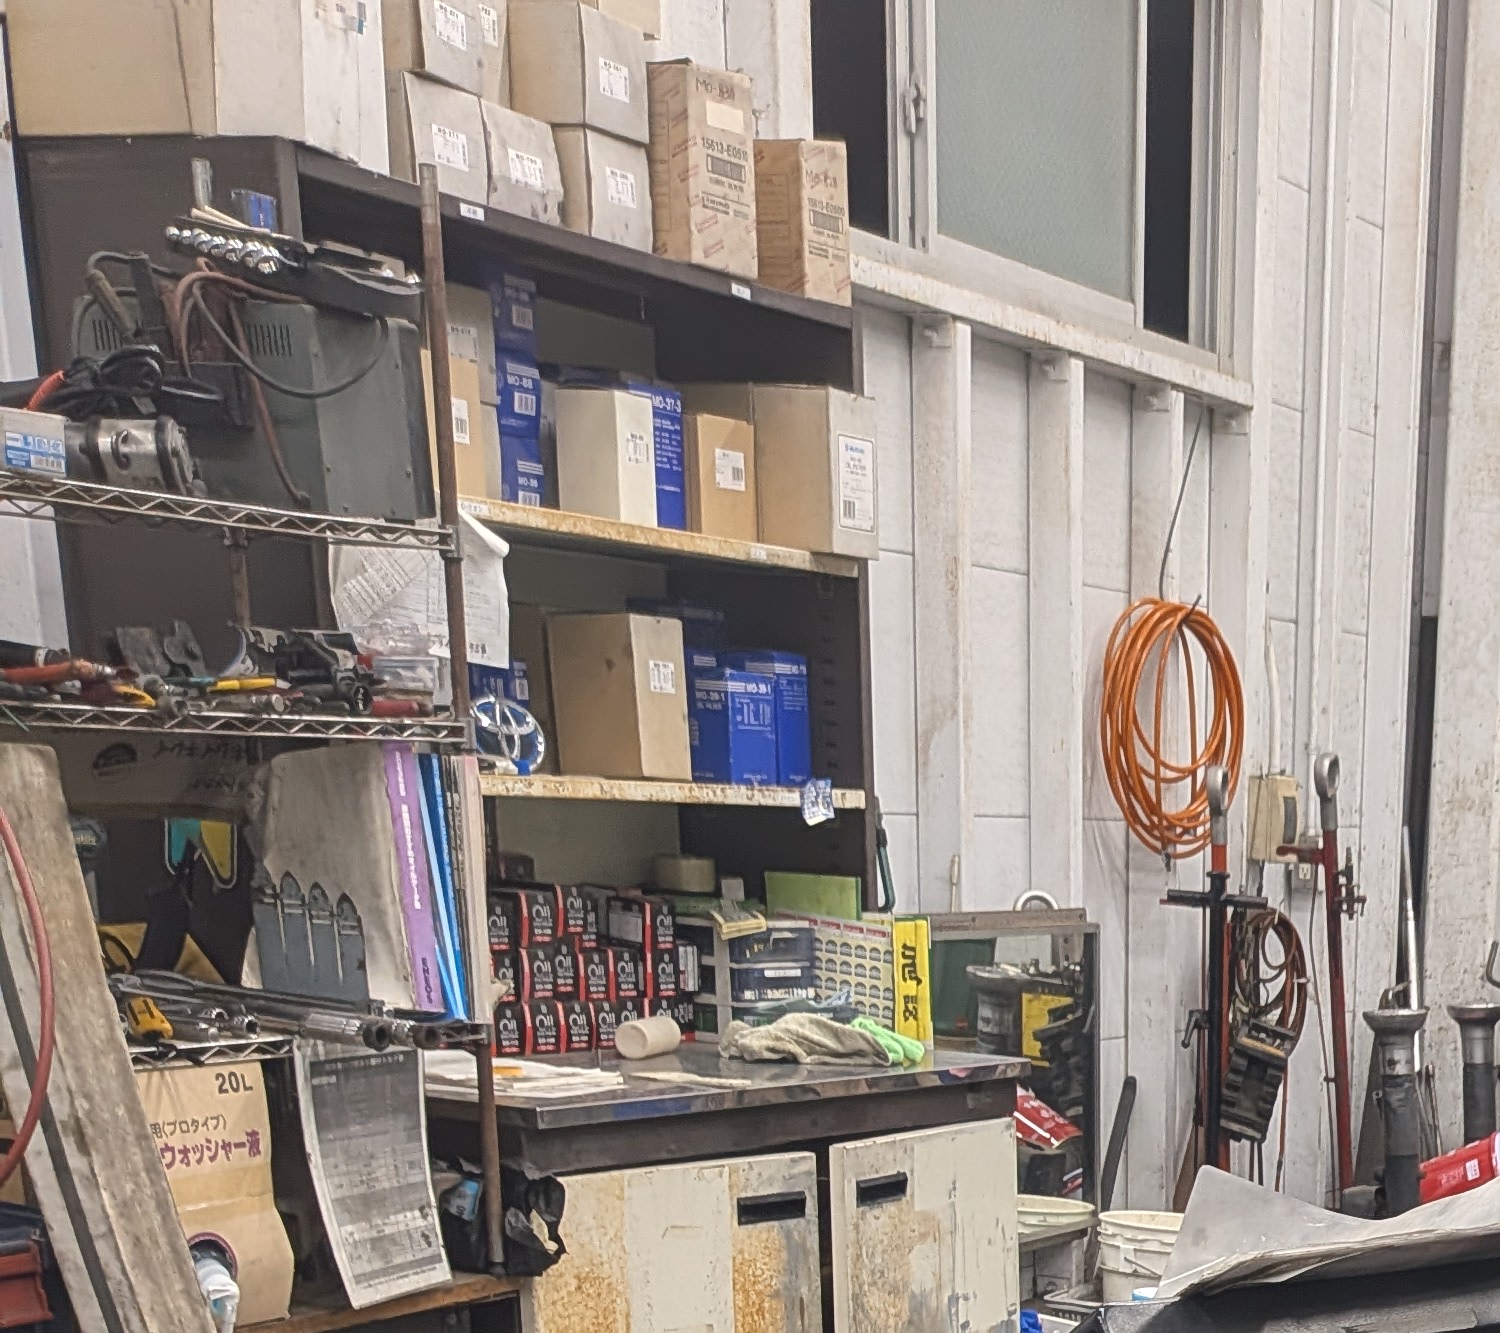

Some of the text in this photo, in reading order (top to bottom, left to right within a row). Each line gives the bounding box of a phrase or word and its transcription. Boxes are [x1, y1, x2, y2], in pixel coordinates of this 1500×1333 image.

[215, 1071, 254, 1095] 20L
[160, 1129, 262, 1170] ウォッシャー液
